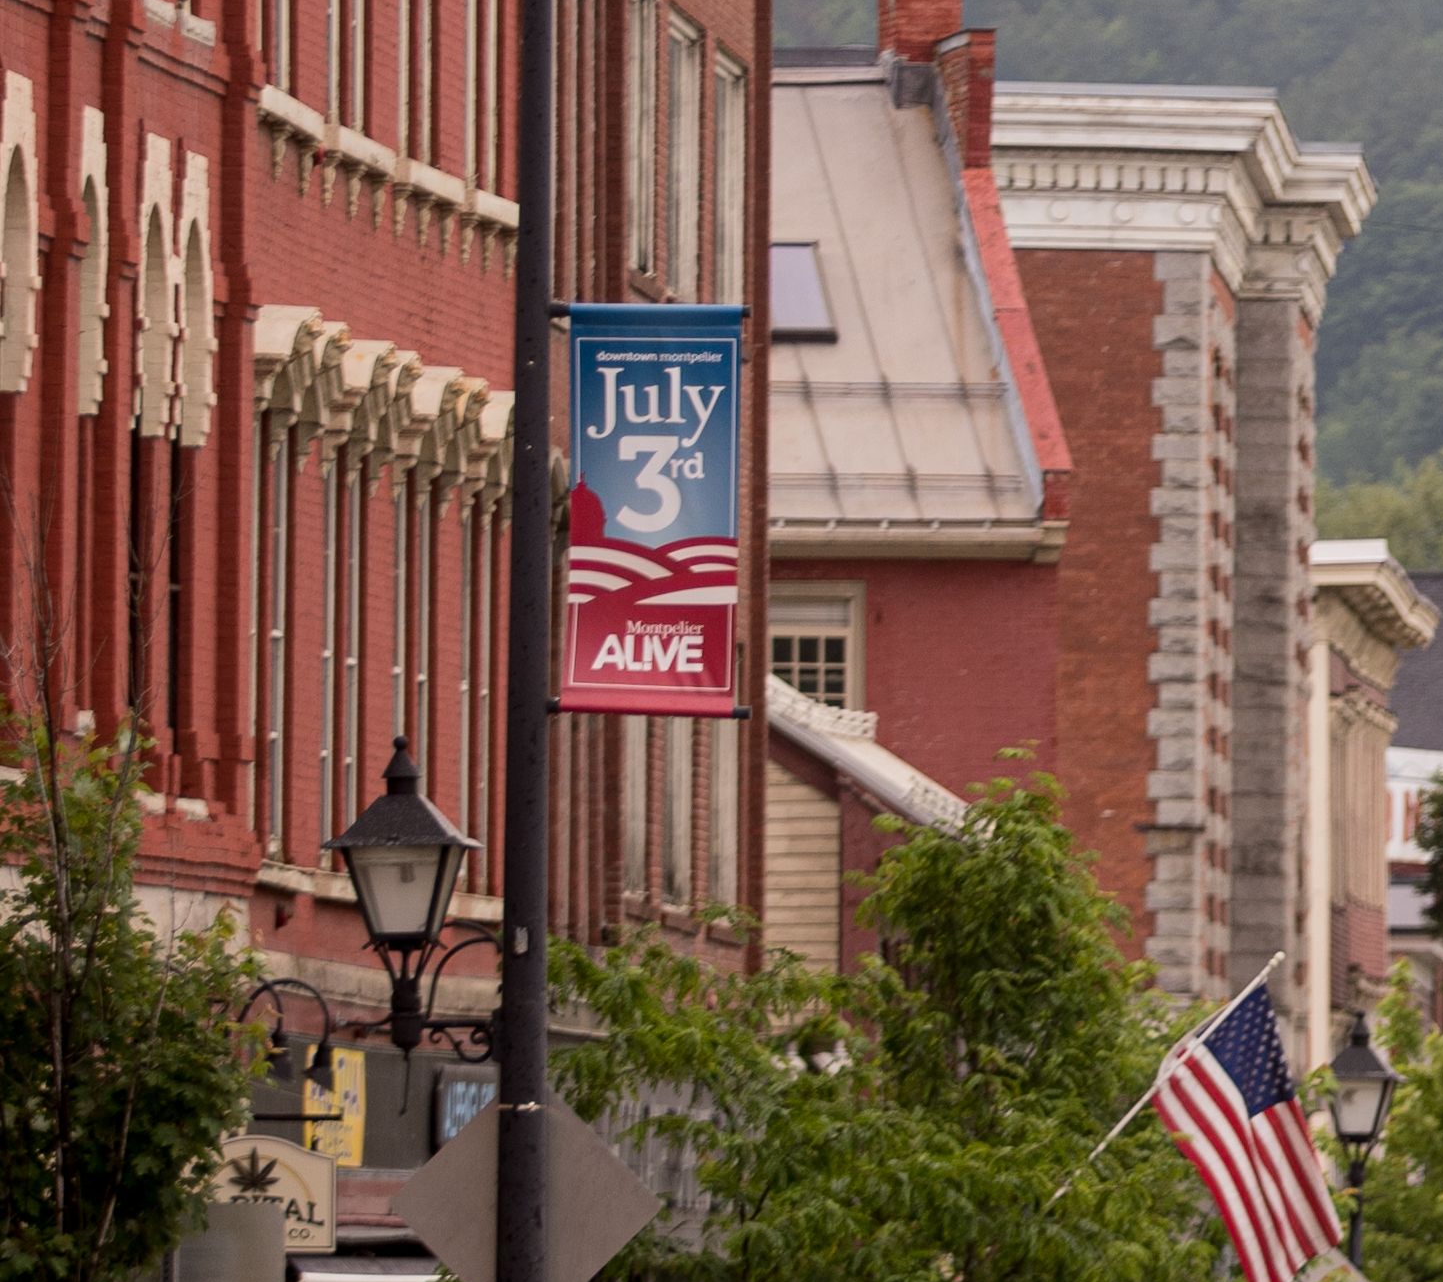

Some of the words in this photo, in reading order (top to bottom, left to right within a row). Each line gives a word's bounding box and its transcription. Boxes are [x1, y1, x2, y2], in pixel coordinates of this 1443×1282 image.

[596, 351, 658, 363] downtown
[659, 351, 723, 365] montpelier
[586, 366, 726, 448] July
[615, 434, 706, 533] 3rd
[627, 620, 705, 638] Montpelier
